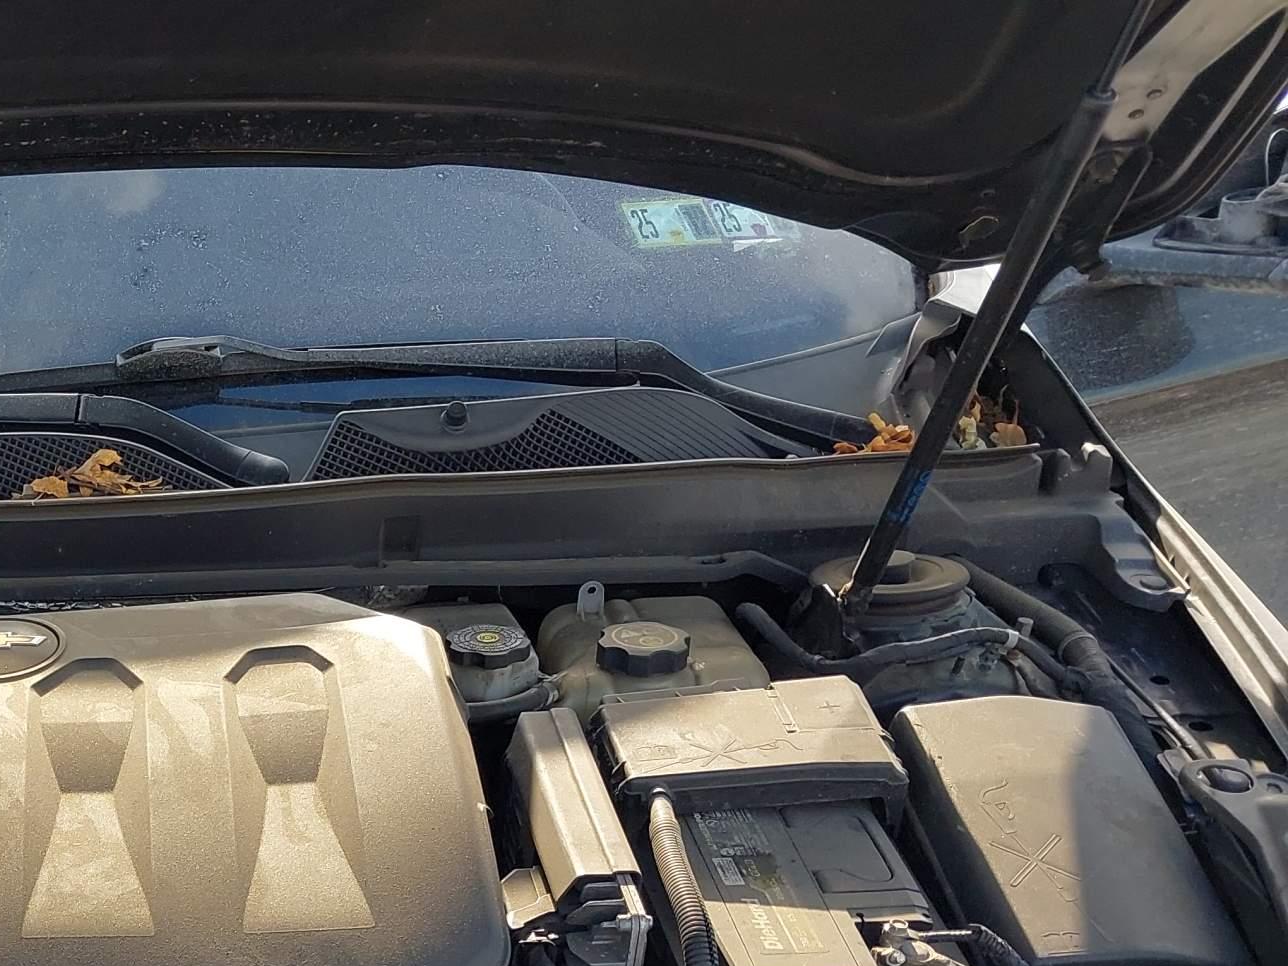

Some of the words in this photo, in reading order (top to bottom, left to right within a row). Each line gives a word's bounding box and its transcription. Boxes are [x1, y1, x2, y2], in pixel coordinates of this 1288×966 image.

[630, 208, 659, 239] 25
[713, 202, 742, 233] 25
[740, 897, 785, 951] DieHard
